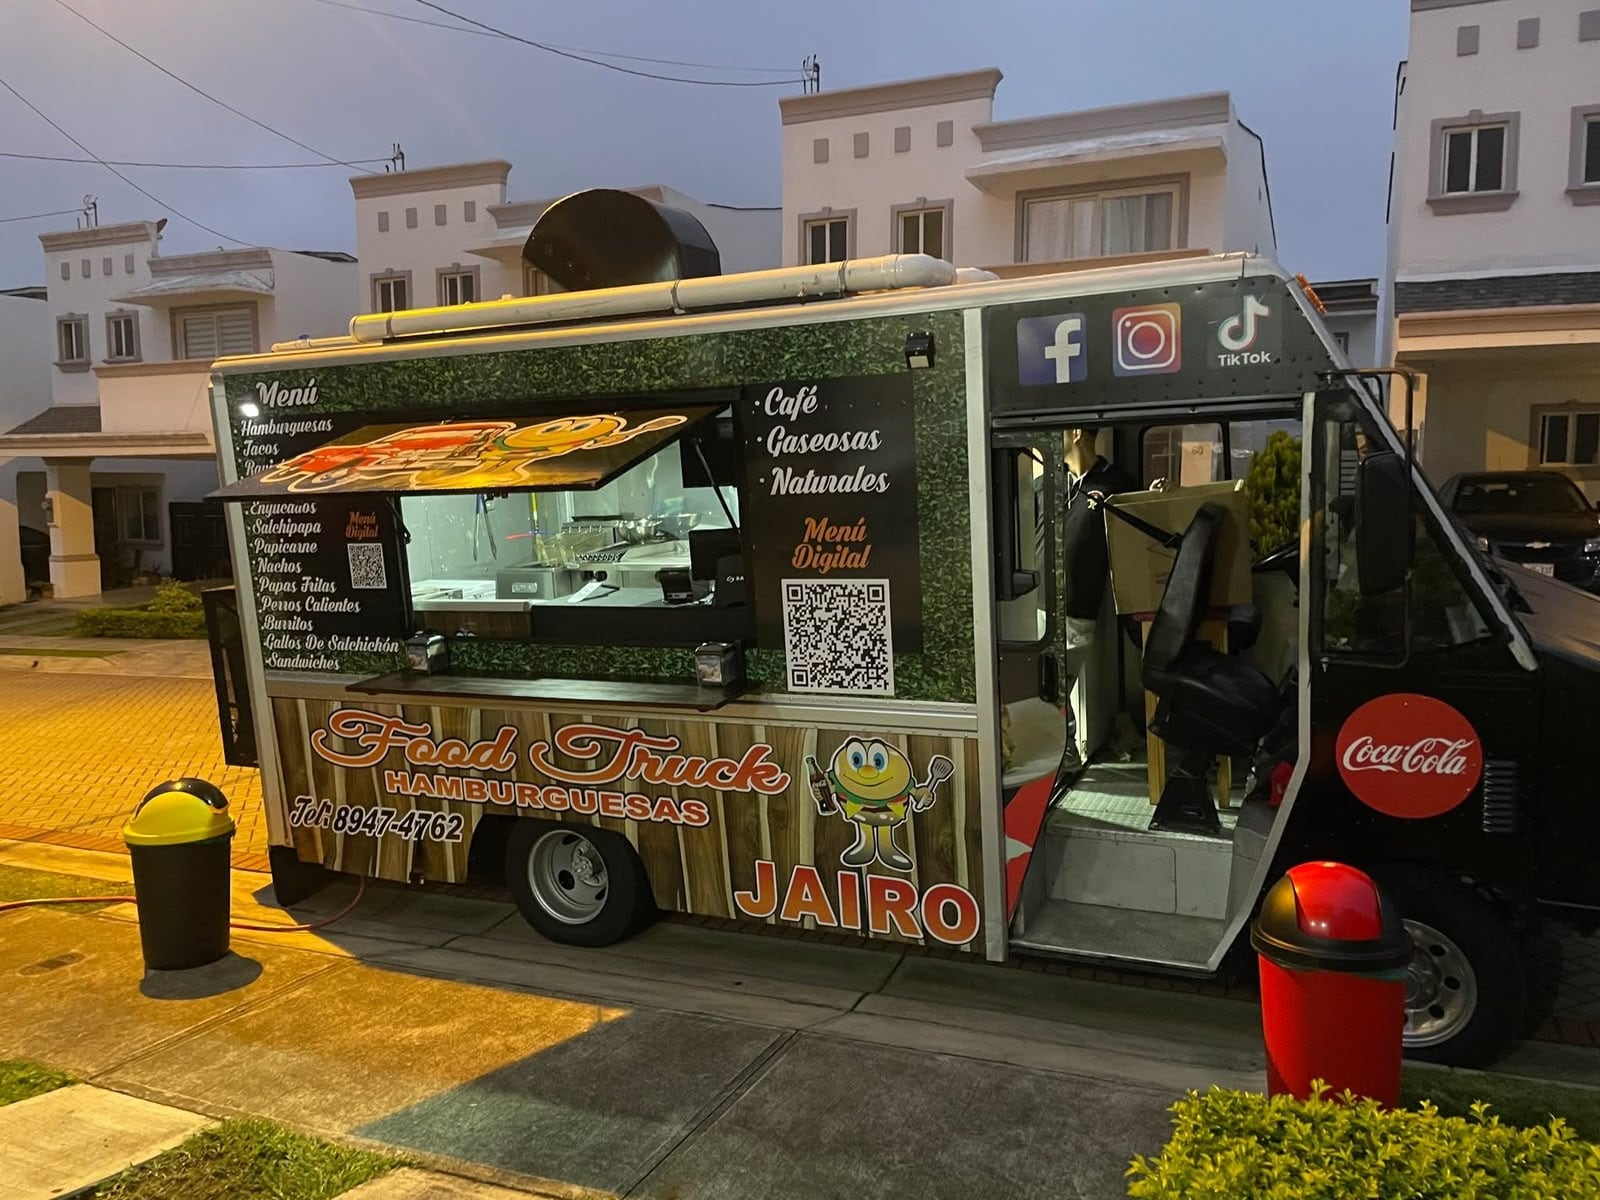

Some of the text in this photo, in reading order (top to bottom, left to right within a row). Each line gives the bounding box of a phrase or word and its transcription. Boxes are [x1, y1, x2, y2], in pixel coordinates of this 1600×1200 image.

[1217, 351, 1271, 367] TikTok
[255, 377, 319, 408] Menú
[764, 385, 818, 421] Café
[240, 418, 334, 437] Hamburguesas
[243, 440, 280, 456] Tacos
[766, 425, 883, 457] Gaseosas
[770, 465, 890, 495] Naturales
[252, 518, 322, 537] Salchipapa
[350, 512, 376, 525] Menú
[345, 525, 379, 540] Digital
[802, 517, 867, 543] Menú
[254, 538, 318, 556] Papicarne
[257, 557, 302, 573] Nachos
[791, 544, 872, 574] Digital
[259, 576, 337, 595] Papas Fritas
[261, 596, 361, 613] Perros Calientes
[263, 614, 314, 631] Burritos
[265, 633, 399, 653] Gallos De Salchichón
[268, 652, 340, 671] Sandwiches
[311, 709, 791, 795] Food Truck
[1343, 736, 1476, 775] Coca-Cola
[384, 770, 710, 826] HAMBURGUESAS
[290, 795, 464, 842] Tel: 8947-4762
[734, 860, 980, 945] JAIRO
